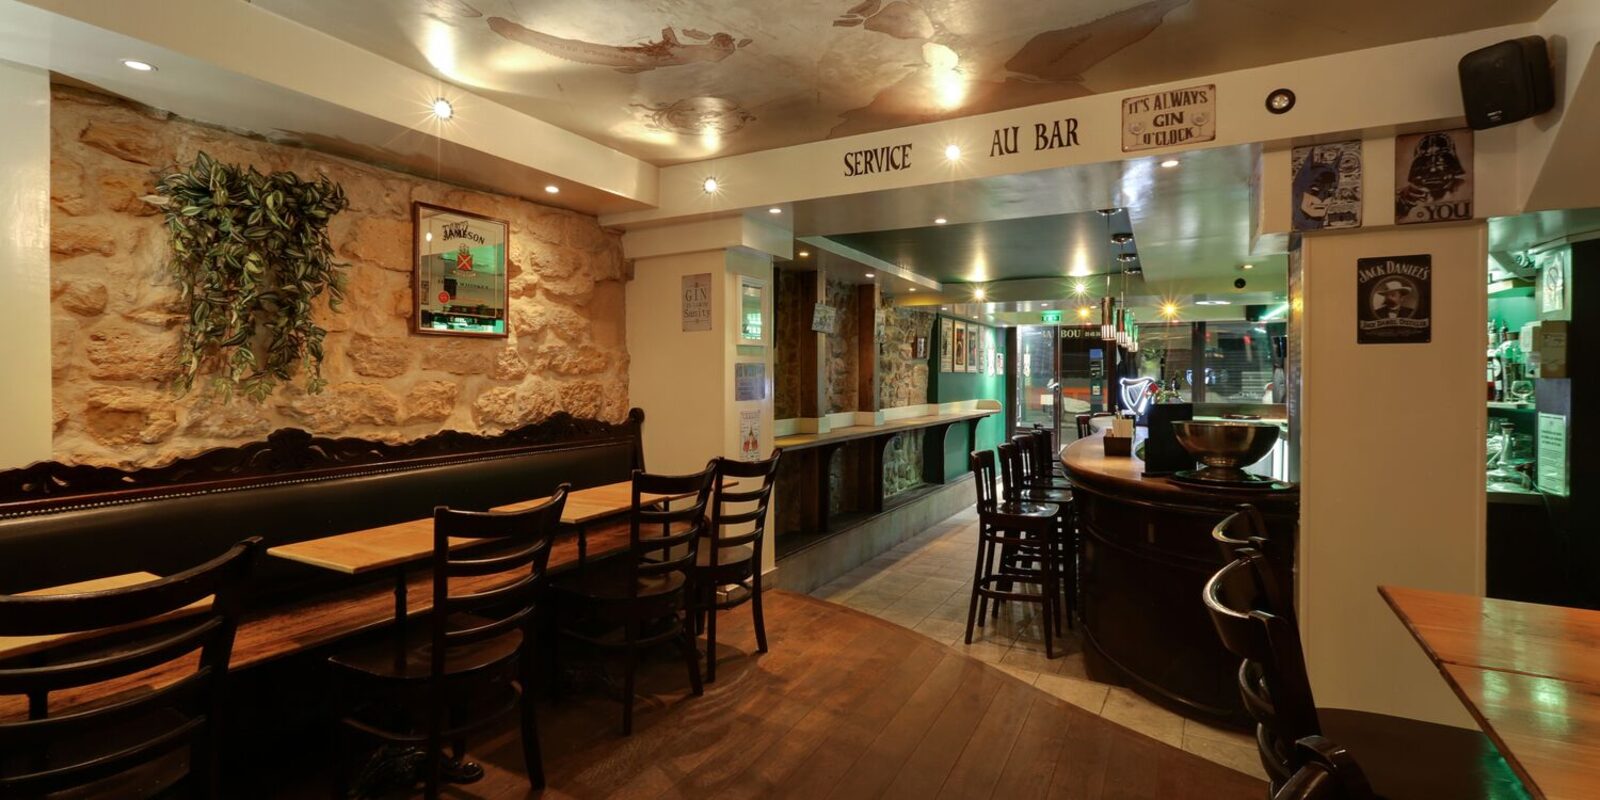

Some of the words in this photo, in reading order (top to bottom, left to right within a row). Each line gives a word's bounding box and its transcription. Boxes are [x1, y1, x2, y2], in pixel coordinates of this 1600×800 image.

[1128, 97, 1150, 115] IT'S
[1153, 90, 1209, 112] ALWAYS
[1152, 111, 1184, 128] GIN
[1143, 127, 1194, 146] O'CLOCK
[844, 143, 912, 177] SERVICE
[990, 126, 1019, 157] AU
[1035, 117, 1080, 151] BAR
[1424, 203, 1470, 220] YOU
[443, 228, 485, 245] JAMESON
[1359, 264, 1385, 283] JACK
[1386, 261, 1430, 281] DANIEL'S
[685, 287, 708, 302] GIN
